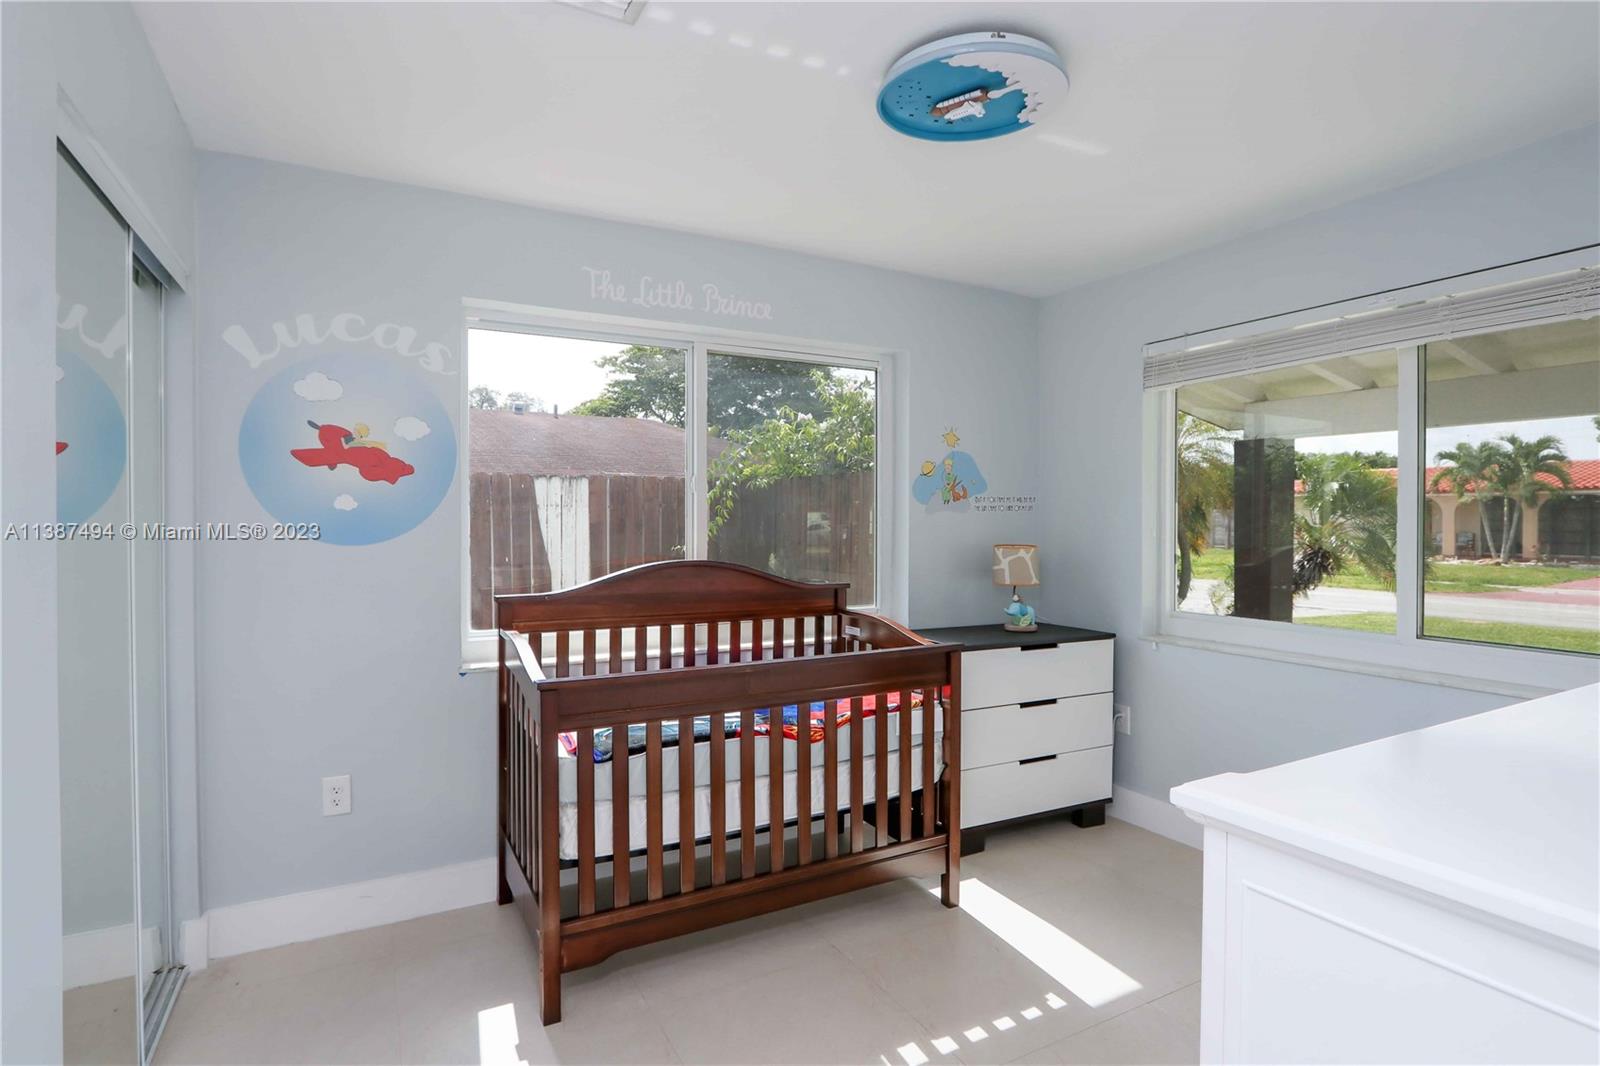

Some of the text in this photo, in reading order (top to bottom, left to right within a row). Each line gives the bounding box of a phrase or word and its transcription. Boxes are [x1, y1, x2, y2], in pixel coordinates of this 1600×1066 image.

[581, 265, 773, 320] The Little Prince
[222, 313, 457, 375] Lucas
